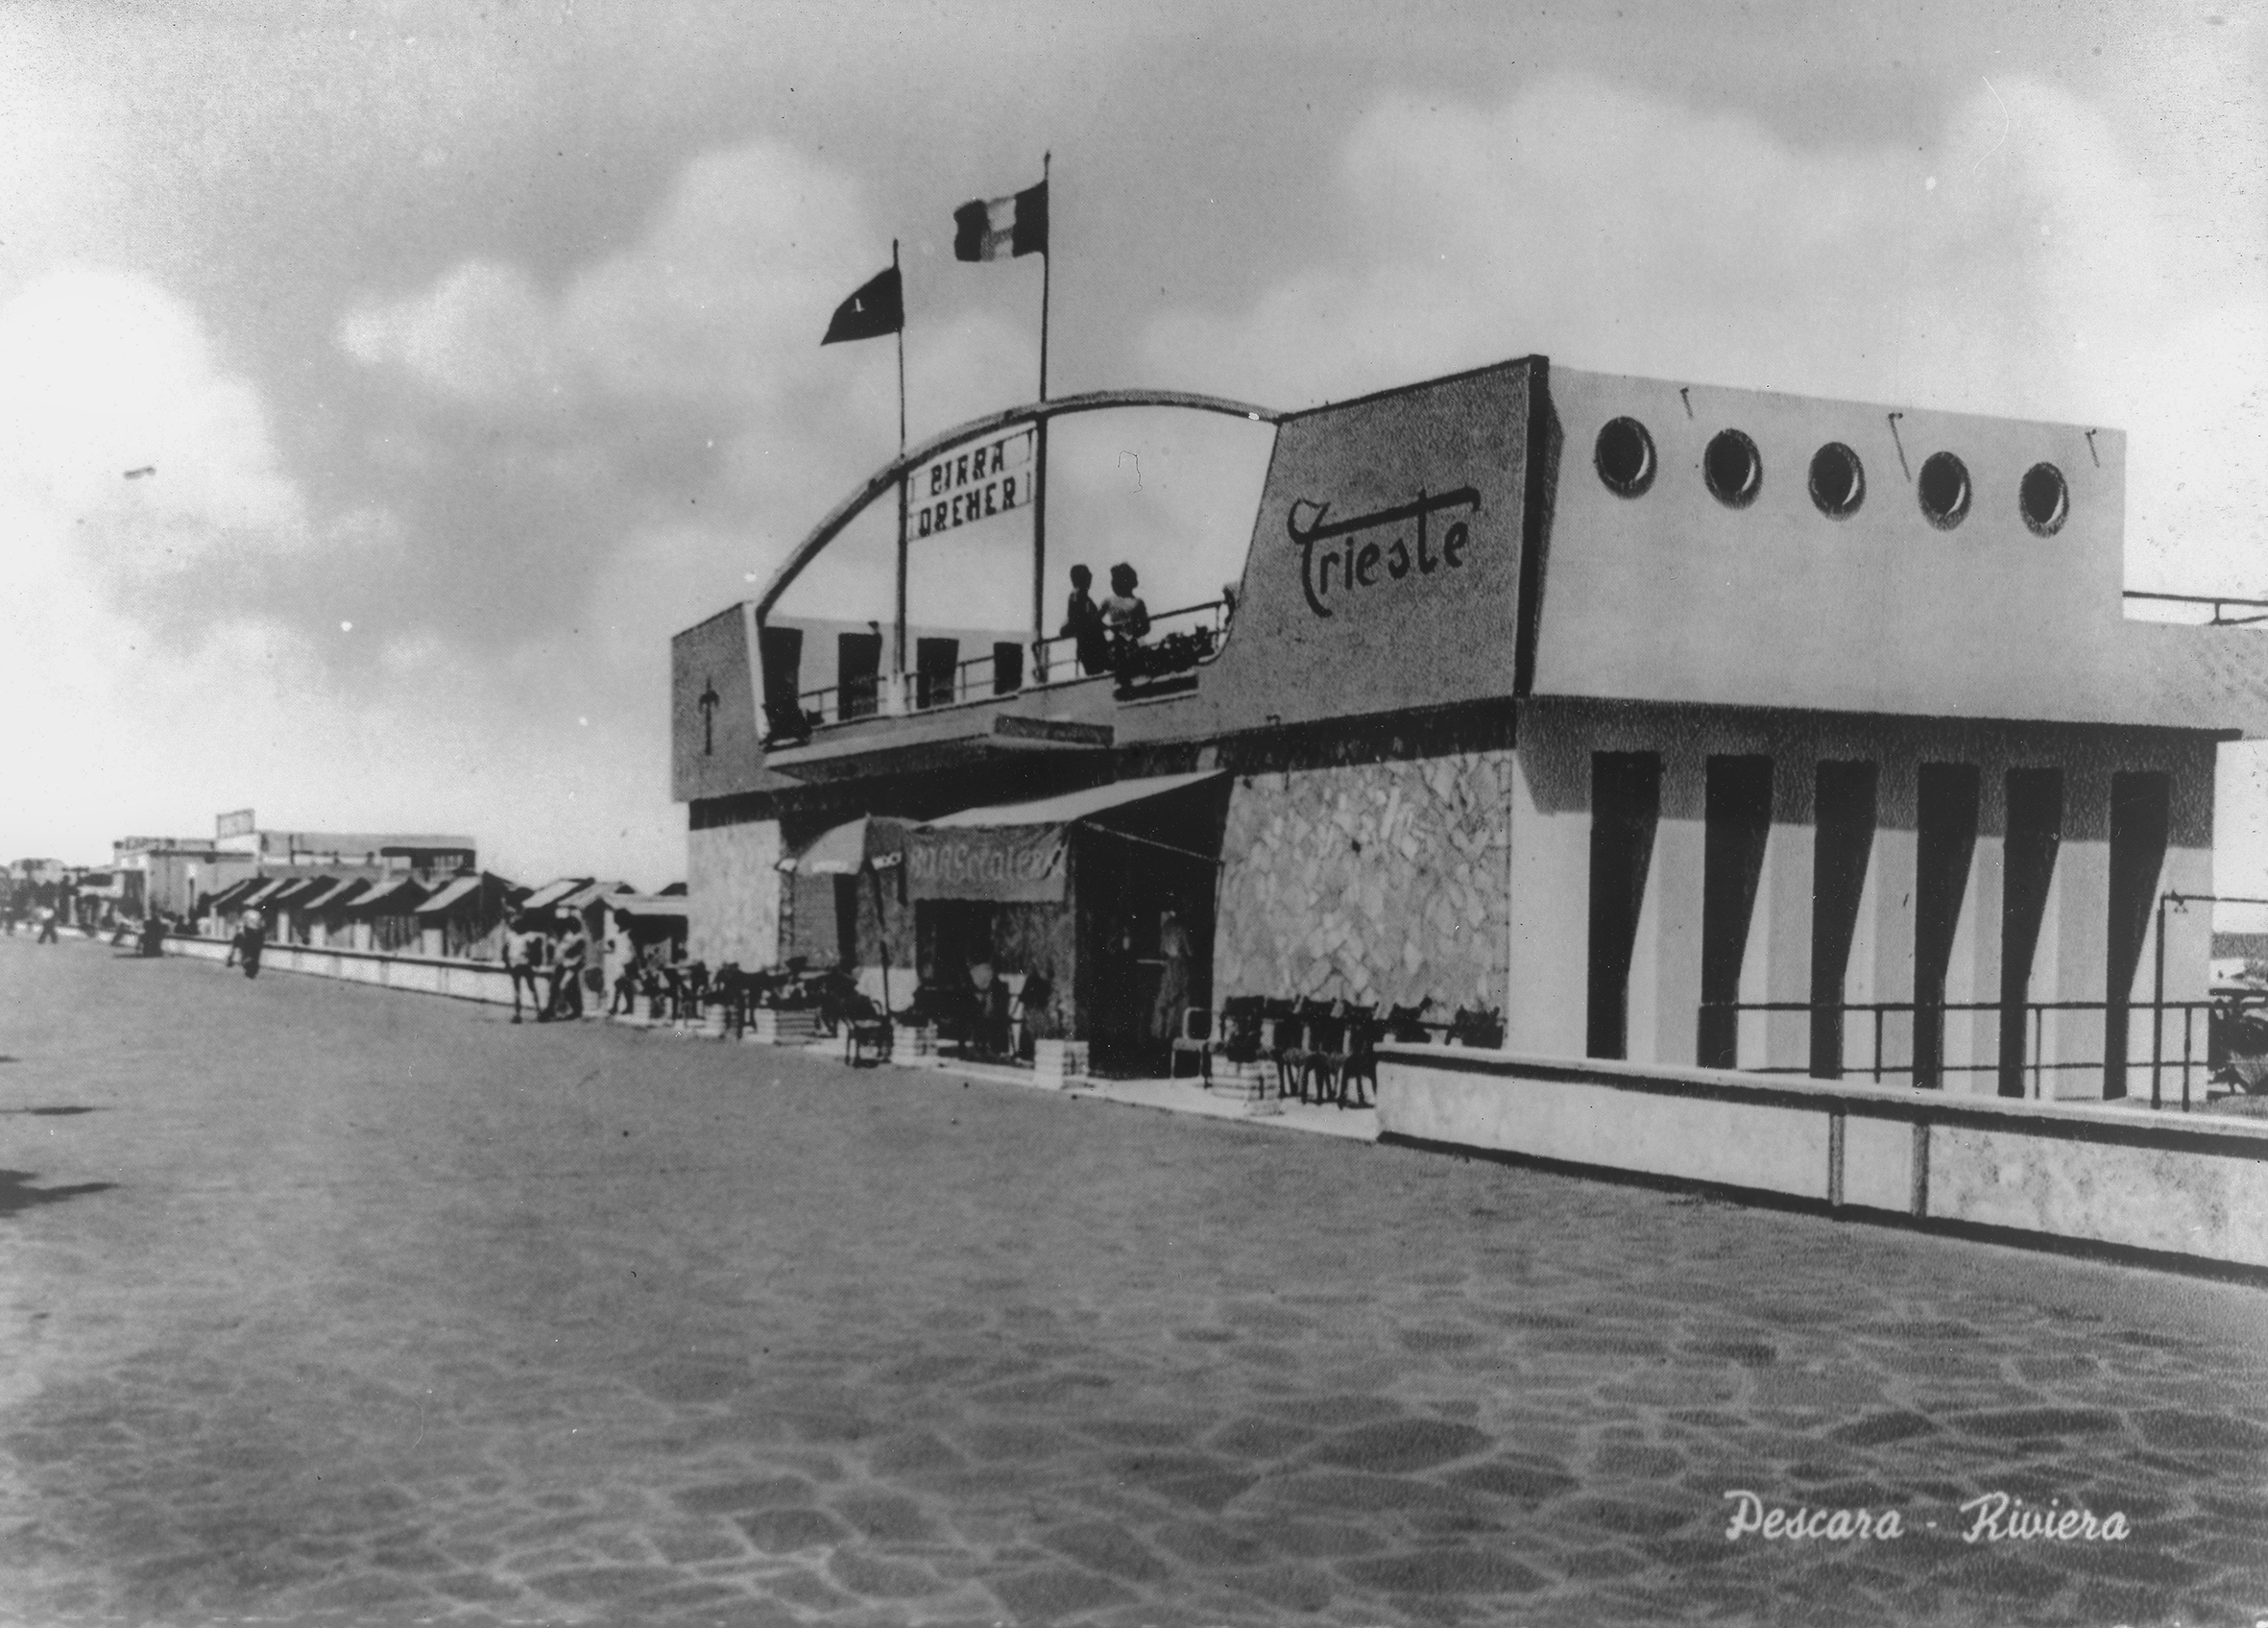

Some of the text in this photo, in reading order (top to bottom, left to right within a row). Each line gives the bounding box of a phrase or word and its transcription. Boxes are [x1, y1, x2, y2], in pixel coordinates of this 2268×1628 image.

[930, 440, 1004, 497] BIRRA
[919, 476, 1016, 538] DREHER
[1287, 483, 1482, 619] Trieste
